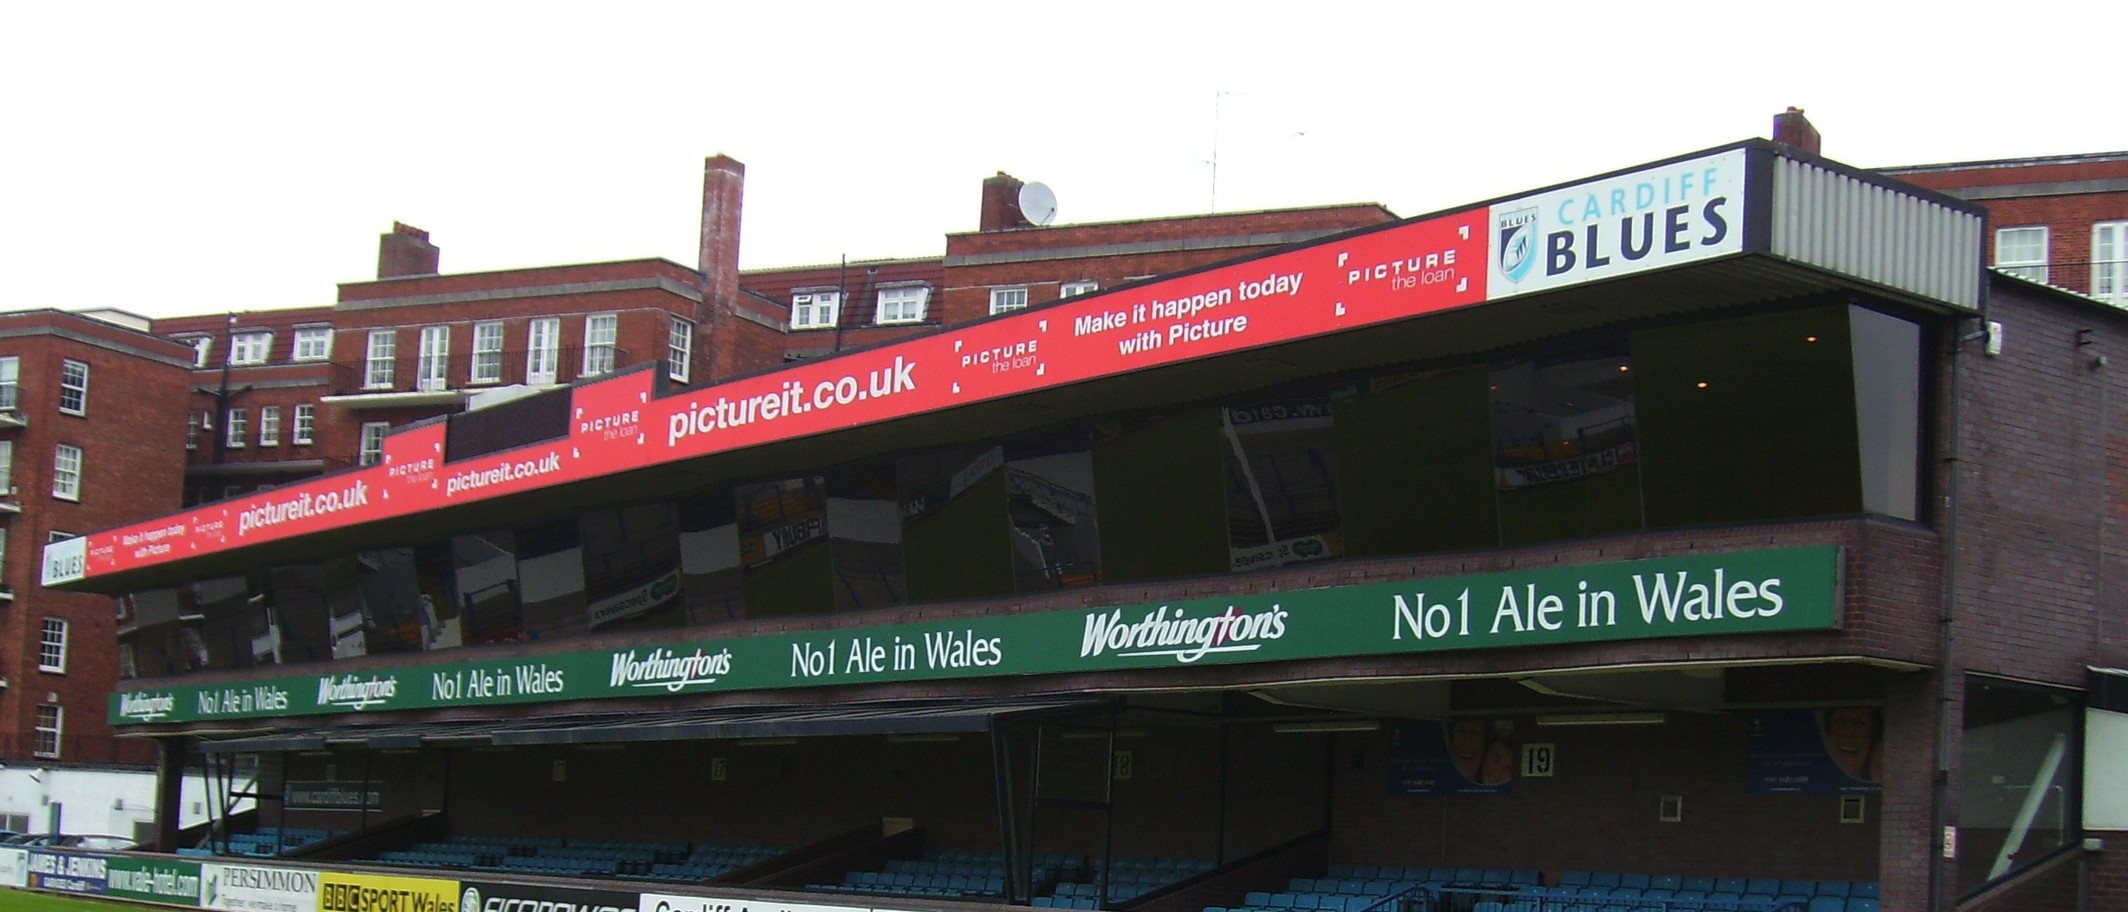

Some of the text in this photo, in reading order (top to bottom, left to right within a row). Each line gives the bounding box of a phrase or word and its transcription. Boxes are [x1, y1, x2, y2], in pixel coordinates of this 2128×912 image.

[1558, 167, 1718, 226] CARDIFF
[1500, 213, 1537, 229] BLUES
[1546, 195, 1728, 277] BLUES
[1348, 250, 1457, 285] PICTURE
[1391, 266, 1456, 292] the loan
[1073, 270, 1304, 338] Make it happen today
[1118, 314, 1248, 356] with Picture
[961, 339, 1039, 368] PICTURE
[991, 354, 1038, 375] the loan
[667, 355, 917, 447] pictureit.co.uk
[580, 410, 640, 434] PICTURE
[388, 457, 435, 478] PICTURE
[446, 451, 561, 497] pictureit.co.uk
[238, 479, 369, 536] pictureit.co.uk
[52, 554, 83, 579] BLUES
[1392, 567, 1785, 640] No1 Ale in Wales
[1078, 603, 1290, 663] Worthington's
[609, 647, 733, 692] Worthington's
[790, 629, 1003, 678] No1 Ale in Wales
[317, 673, 399, 711] Worthington's
[467, 669, 494, 698] Ale
[496, 668, 512, 696] in
[515, 663, 564, 695] Wales
[221, 689, 241, 712] Ale
[242, 689, 252, 711] in
[254, 685, 288, 711] Wales
[1528, 747, 1550, 774] 19
[56, 855, 65, 875] &
[223, 867, 316, 893] PERSIMMON
[322, 883, 455, 912] BBC SPORT Wales
